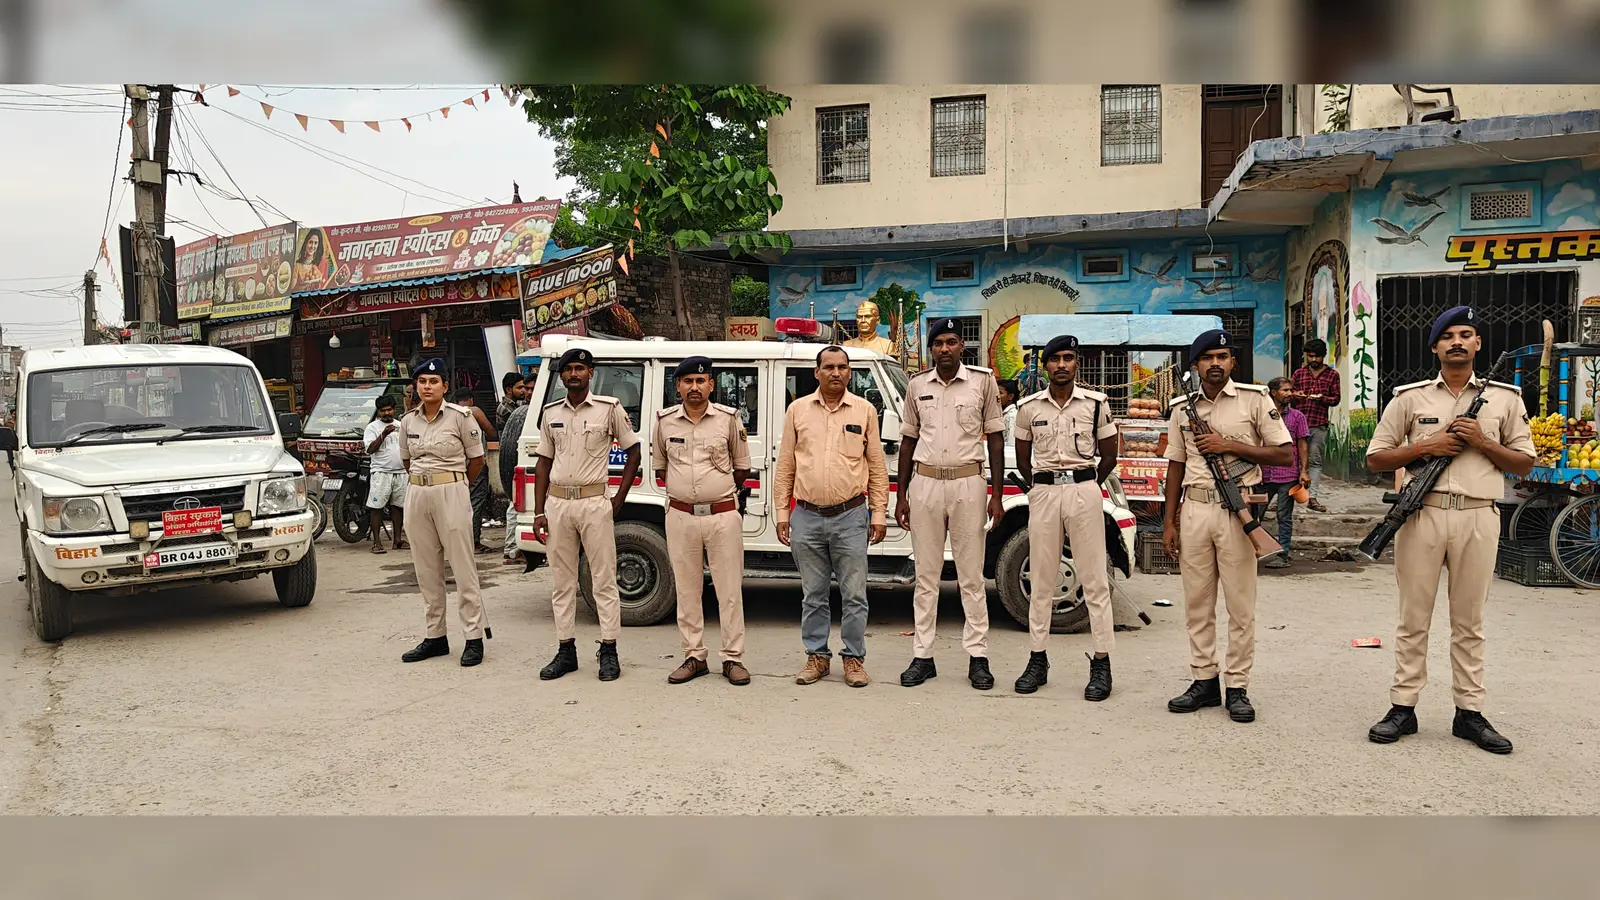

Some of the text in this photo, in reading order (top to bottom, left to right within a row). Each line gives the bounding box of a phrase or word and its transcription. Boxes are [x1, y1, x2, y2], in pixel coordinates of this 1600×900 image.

[338, 236, 401, 262] जगदम्बा
[456, 232, 464, 244] &
[469, 220, 504, 246] केक
[528, 272, 564, 296] BLUE
[566, 258, 612, 283] MOON
[981, 284, 998, 300] शिक्षा
[1034, 272, 1049, 285] शिक्षा
[730, 324, 758, 338] स्वच्छ
[1126, 466, 1159, 478] पाव
[165, 513, 188, 522] बिहार
[274, 524, 305, 536] सरकार
[55, 547, 100, 560] बिहार
[161, 554, 178, 563] BR
[180, 550, 202, 561] 04J
